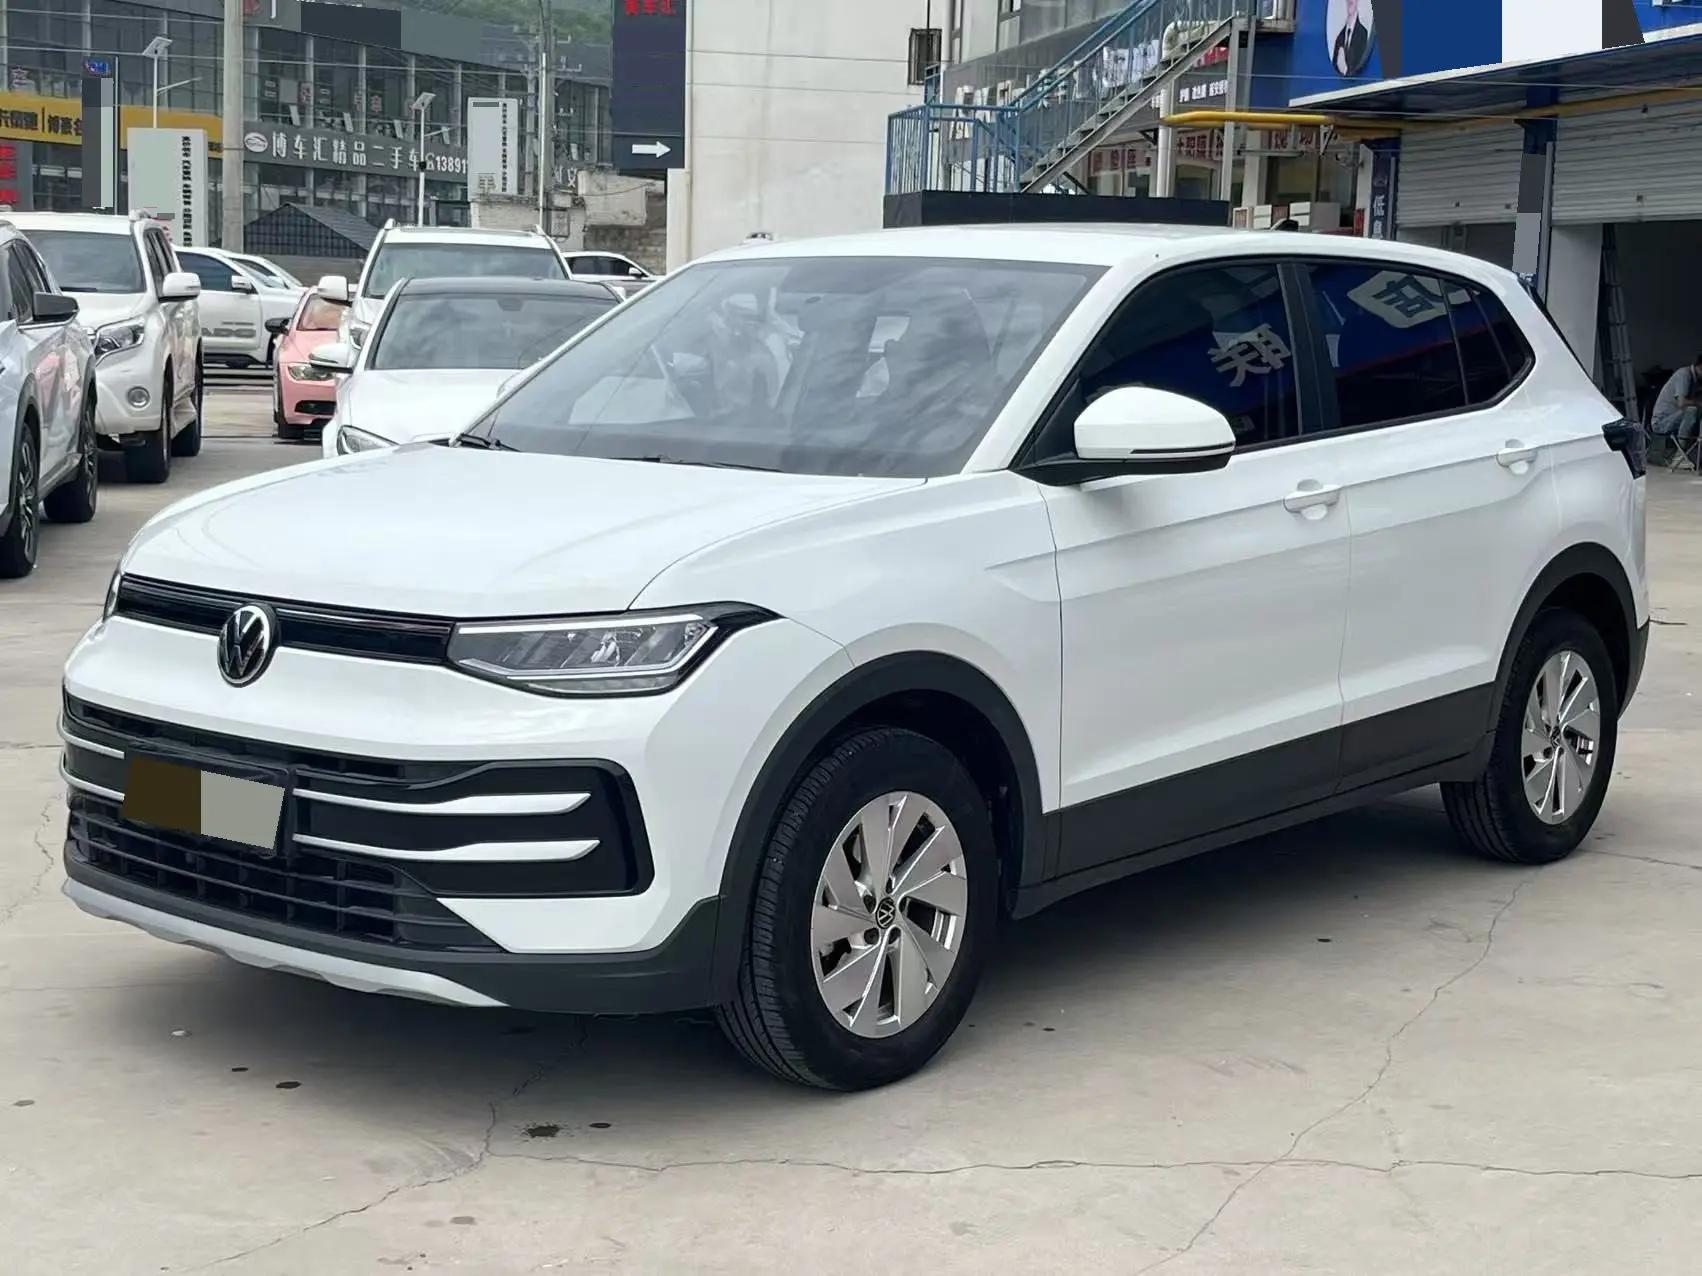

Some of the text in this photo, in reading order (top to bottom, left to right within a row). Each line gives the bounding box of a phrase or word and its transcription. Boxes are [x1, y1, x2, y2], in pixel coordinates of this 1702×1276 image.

[272, 131, 420, 172] 博车汇精品二手车
